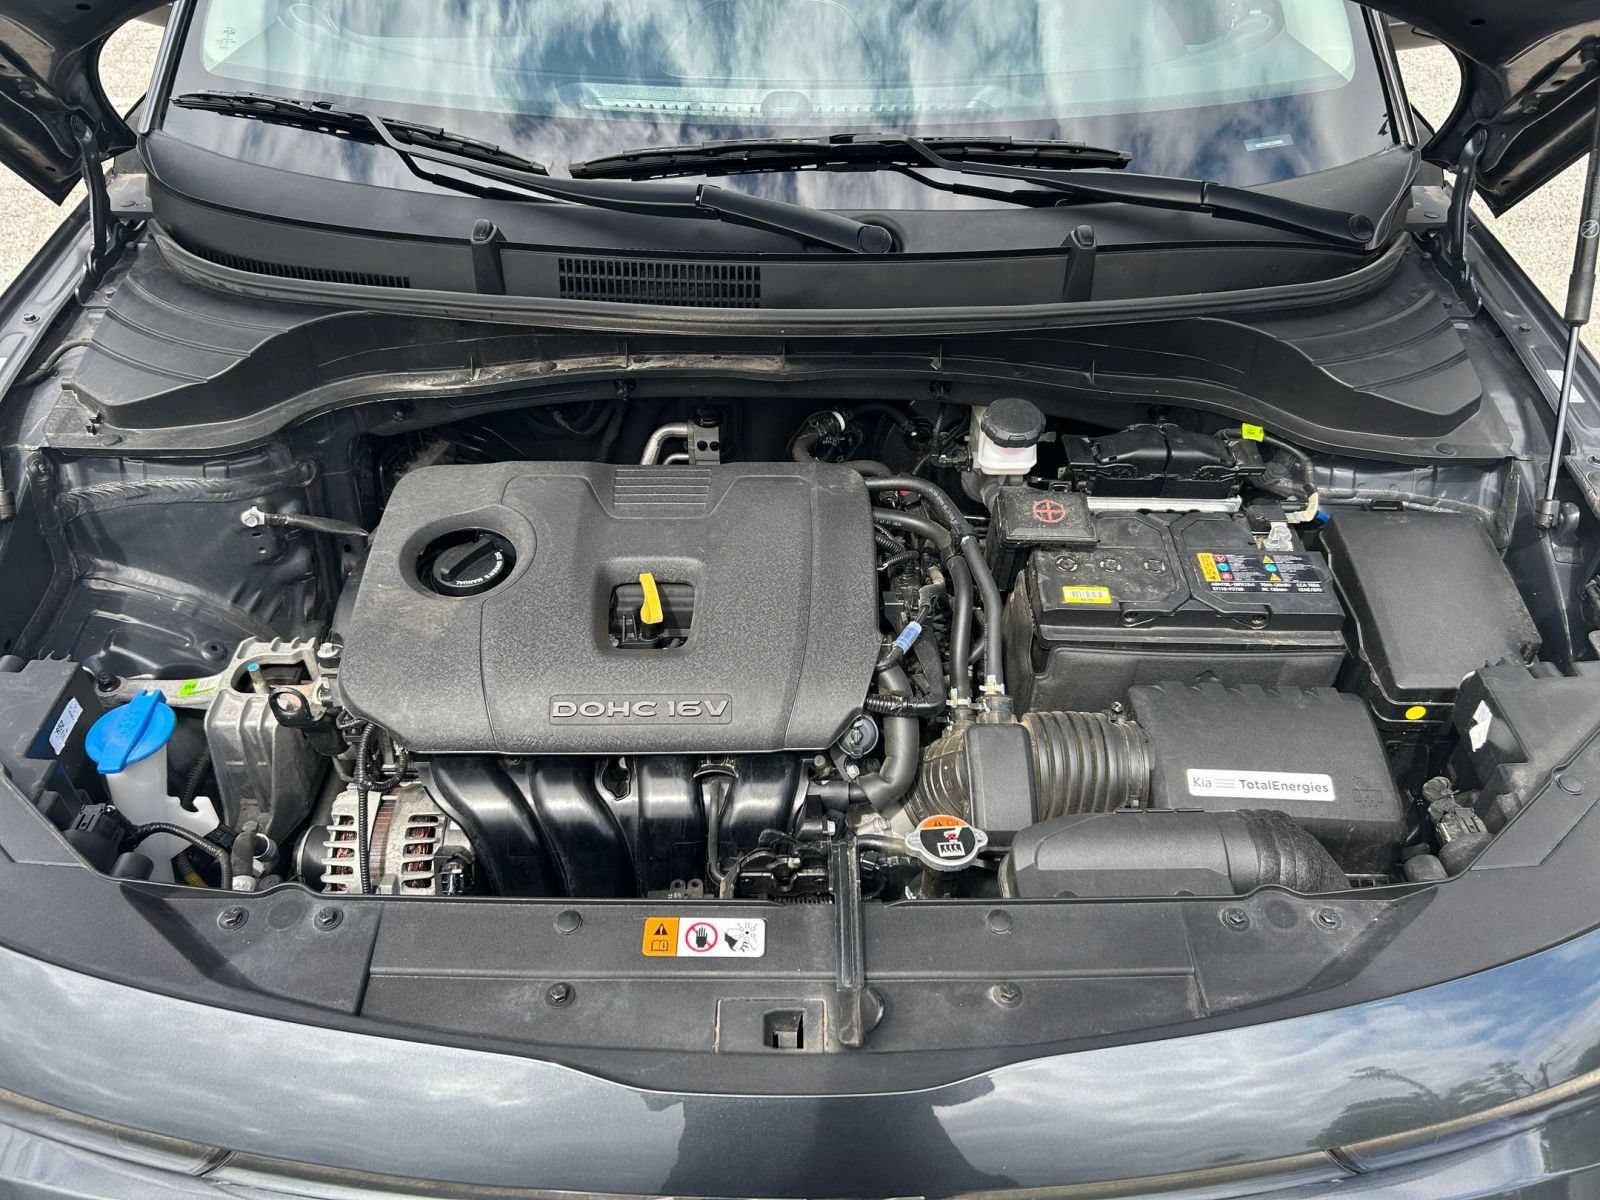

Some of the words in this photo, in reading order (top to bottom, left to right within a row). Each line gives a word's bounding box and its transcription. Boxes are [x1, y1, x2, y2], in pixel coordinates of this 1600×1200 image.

[494, 551, 503, 560] SEE
[456, 577, 483, 585] MANUAL
[552, 700, 658, 718] DOHC
[668, 700, 730, 718] 16V
[1192, 776, 1212, 789] Kia
[1239, 779, 1329, 794] TotalEnergies
